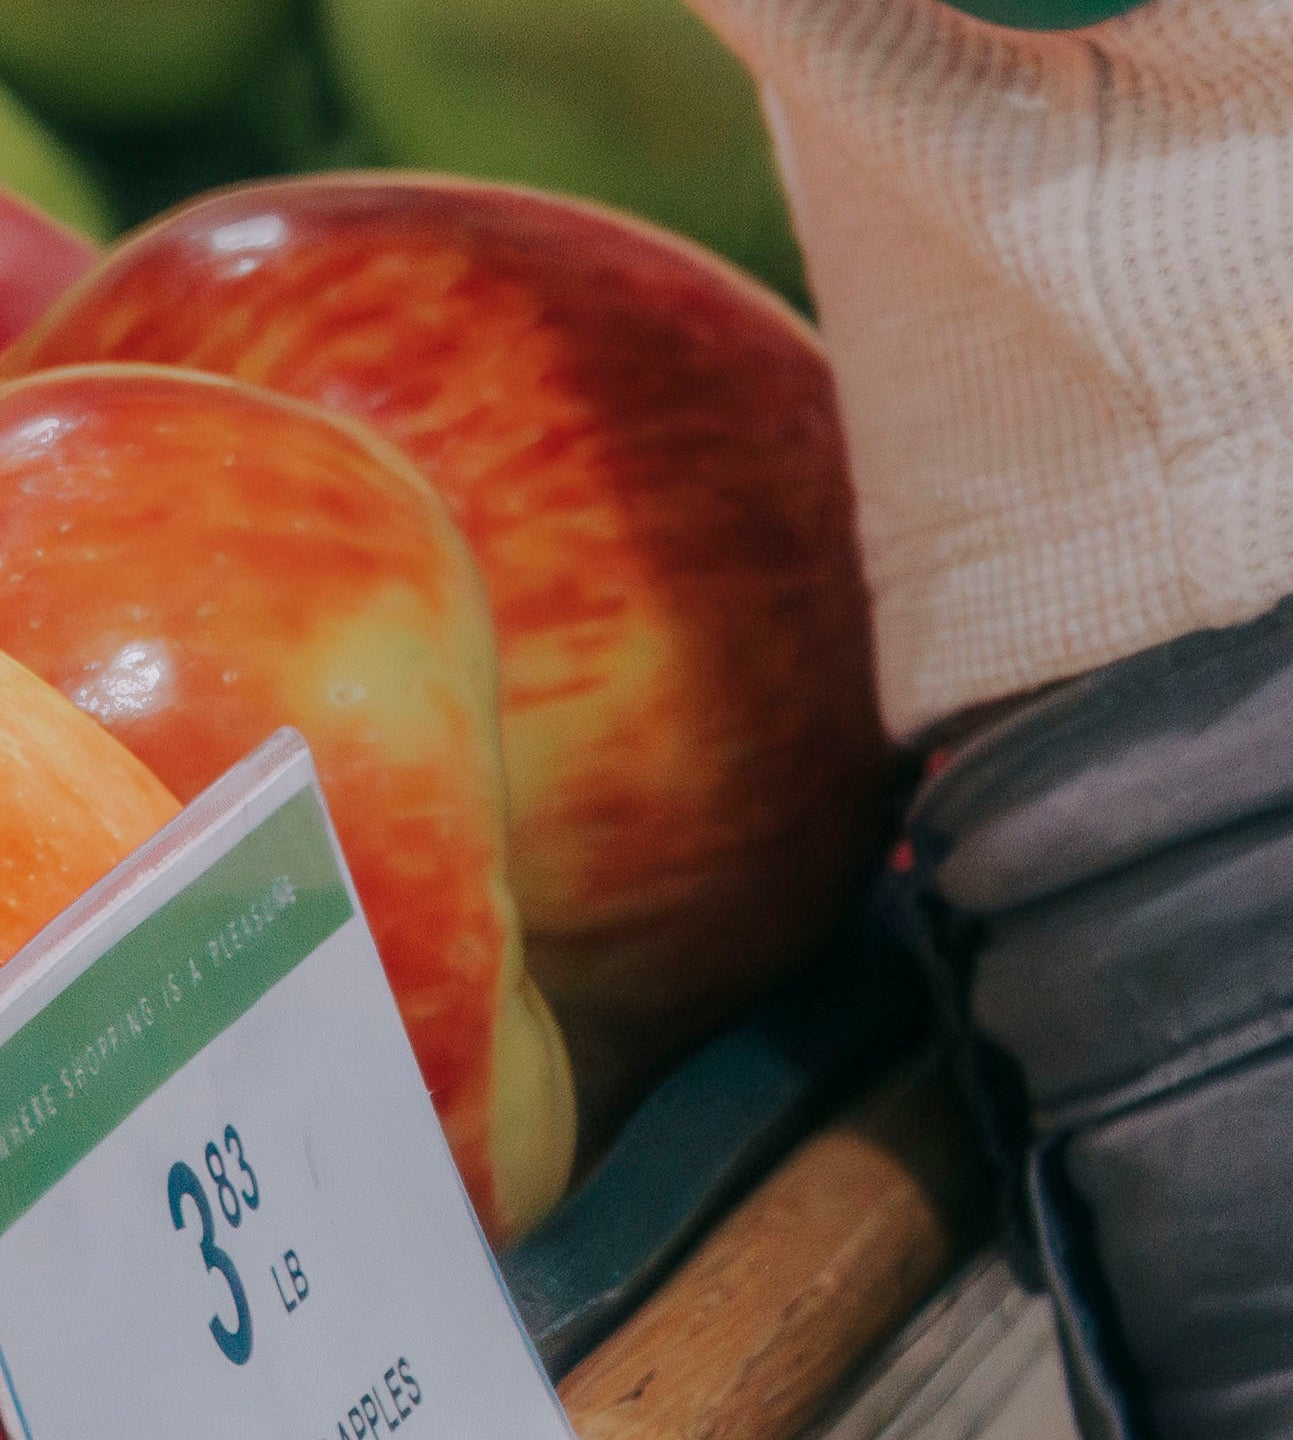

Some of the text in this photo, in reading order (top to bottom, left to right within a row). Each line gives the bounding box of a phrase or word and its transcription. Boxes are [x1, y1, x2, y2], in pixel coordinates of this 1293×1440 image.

[162, 971, 182, 1010] IS
[187, 957, 203, 989] A
[207, 875, 297, 969] PLEASU
[270, 1248, 311, 1315] LB
